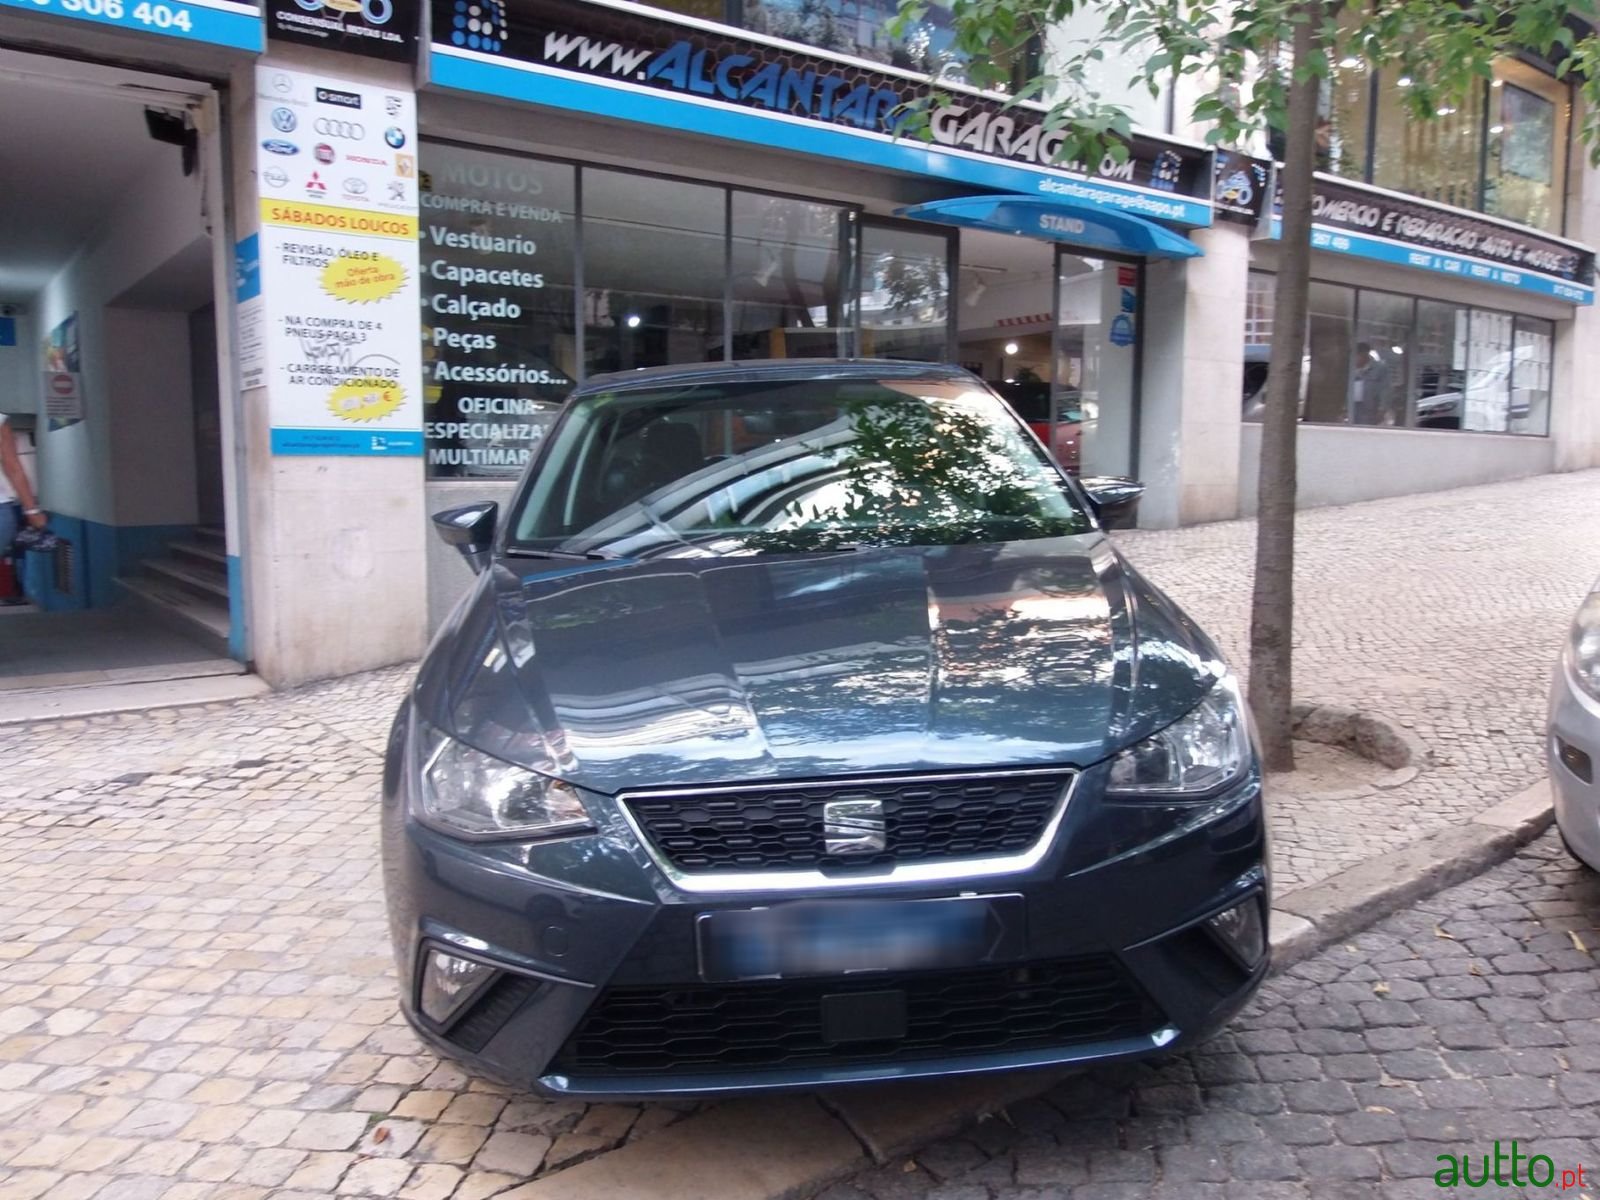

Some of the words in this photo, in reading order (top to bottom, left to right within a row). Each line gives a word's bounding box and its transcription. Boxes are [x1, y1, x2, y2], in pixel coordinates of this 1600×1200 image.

[133, 3, 193, 32] 404
[445, 161, 543, 195] MOTOS
[420, 194, 492, 215] COMPRA
[496, 202, 506, 216] E
[509, 204, 563, 223] VENDA
[1311, 194, 1380, 228] OMERCIO
[272, 206, 347, 229] SÁBADOS
[350, 218, 410, 235] LOUCOS
[1039, 213, 1085, 234] STAND
[429, 225, 537, 255] Vestuario
[282, 255, 329, 268] FILTROS
[339, 246, 369, 261] ÓLEO
[372, 252, 379, 261] E
[431, 259, 544, 288] Capacetes
[432, 293, 521, 320] Calçado
[285, 315, 302, 326] NA
[305, 316, 355, 329] COMPRA
[358, 321, 373, 330] DE
[361, 333, 367, 341] 3
[433, 327, 497, 353] Peças
[286, 363, 382, 377] CARREGAMENTO
[384, 367, 400, 377] DE
[434, 361, 568, 384] Acessórios...
[289, 376, 304, 385] AR
[307, 376, 397, 388] CONDICIONADO
[457, 397, 537, 415] OFICINA
[425, 422, 549, 440] ESPECIALIZA
